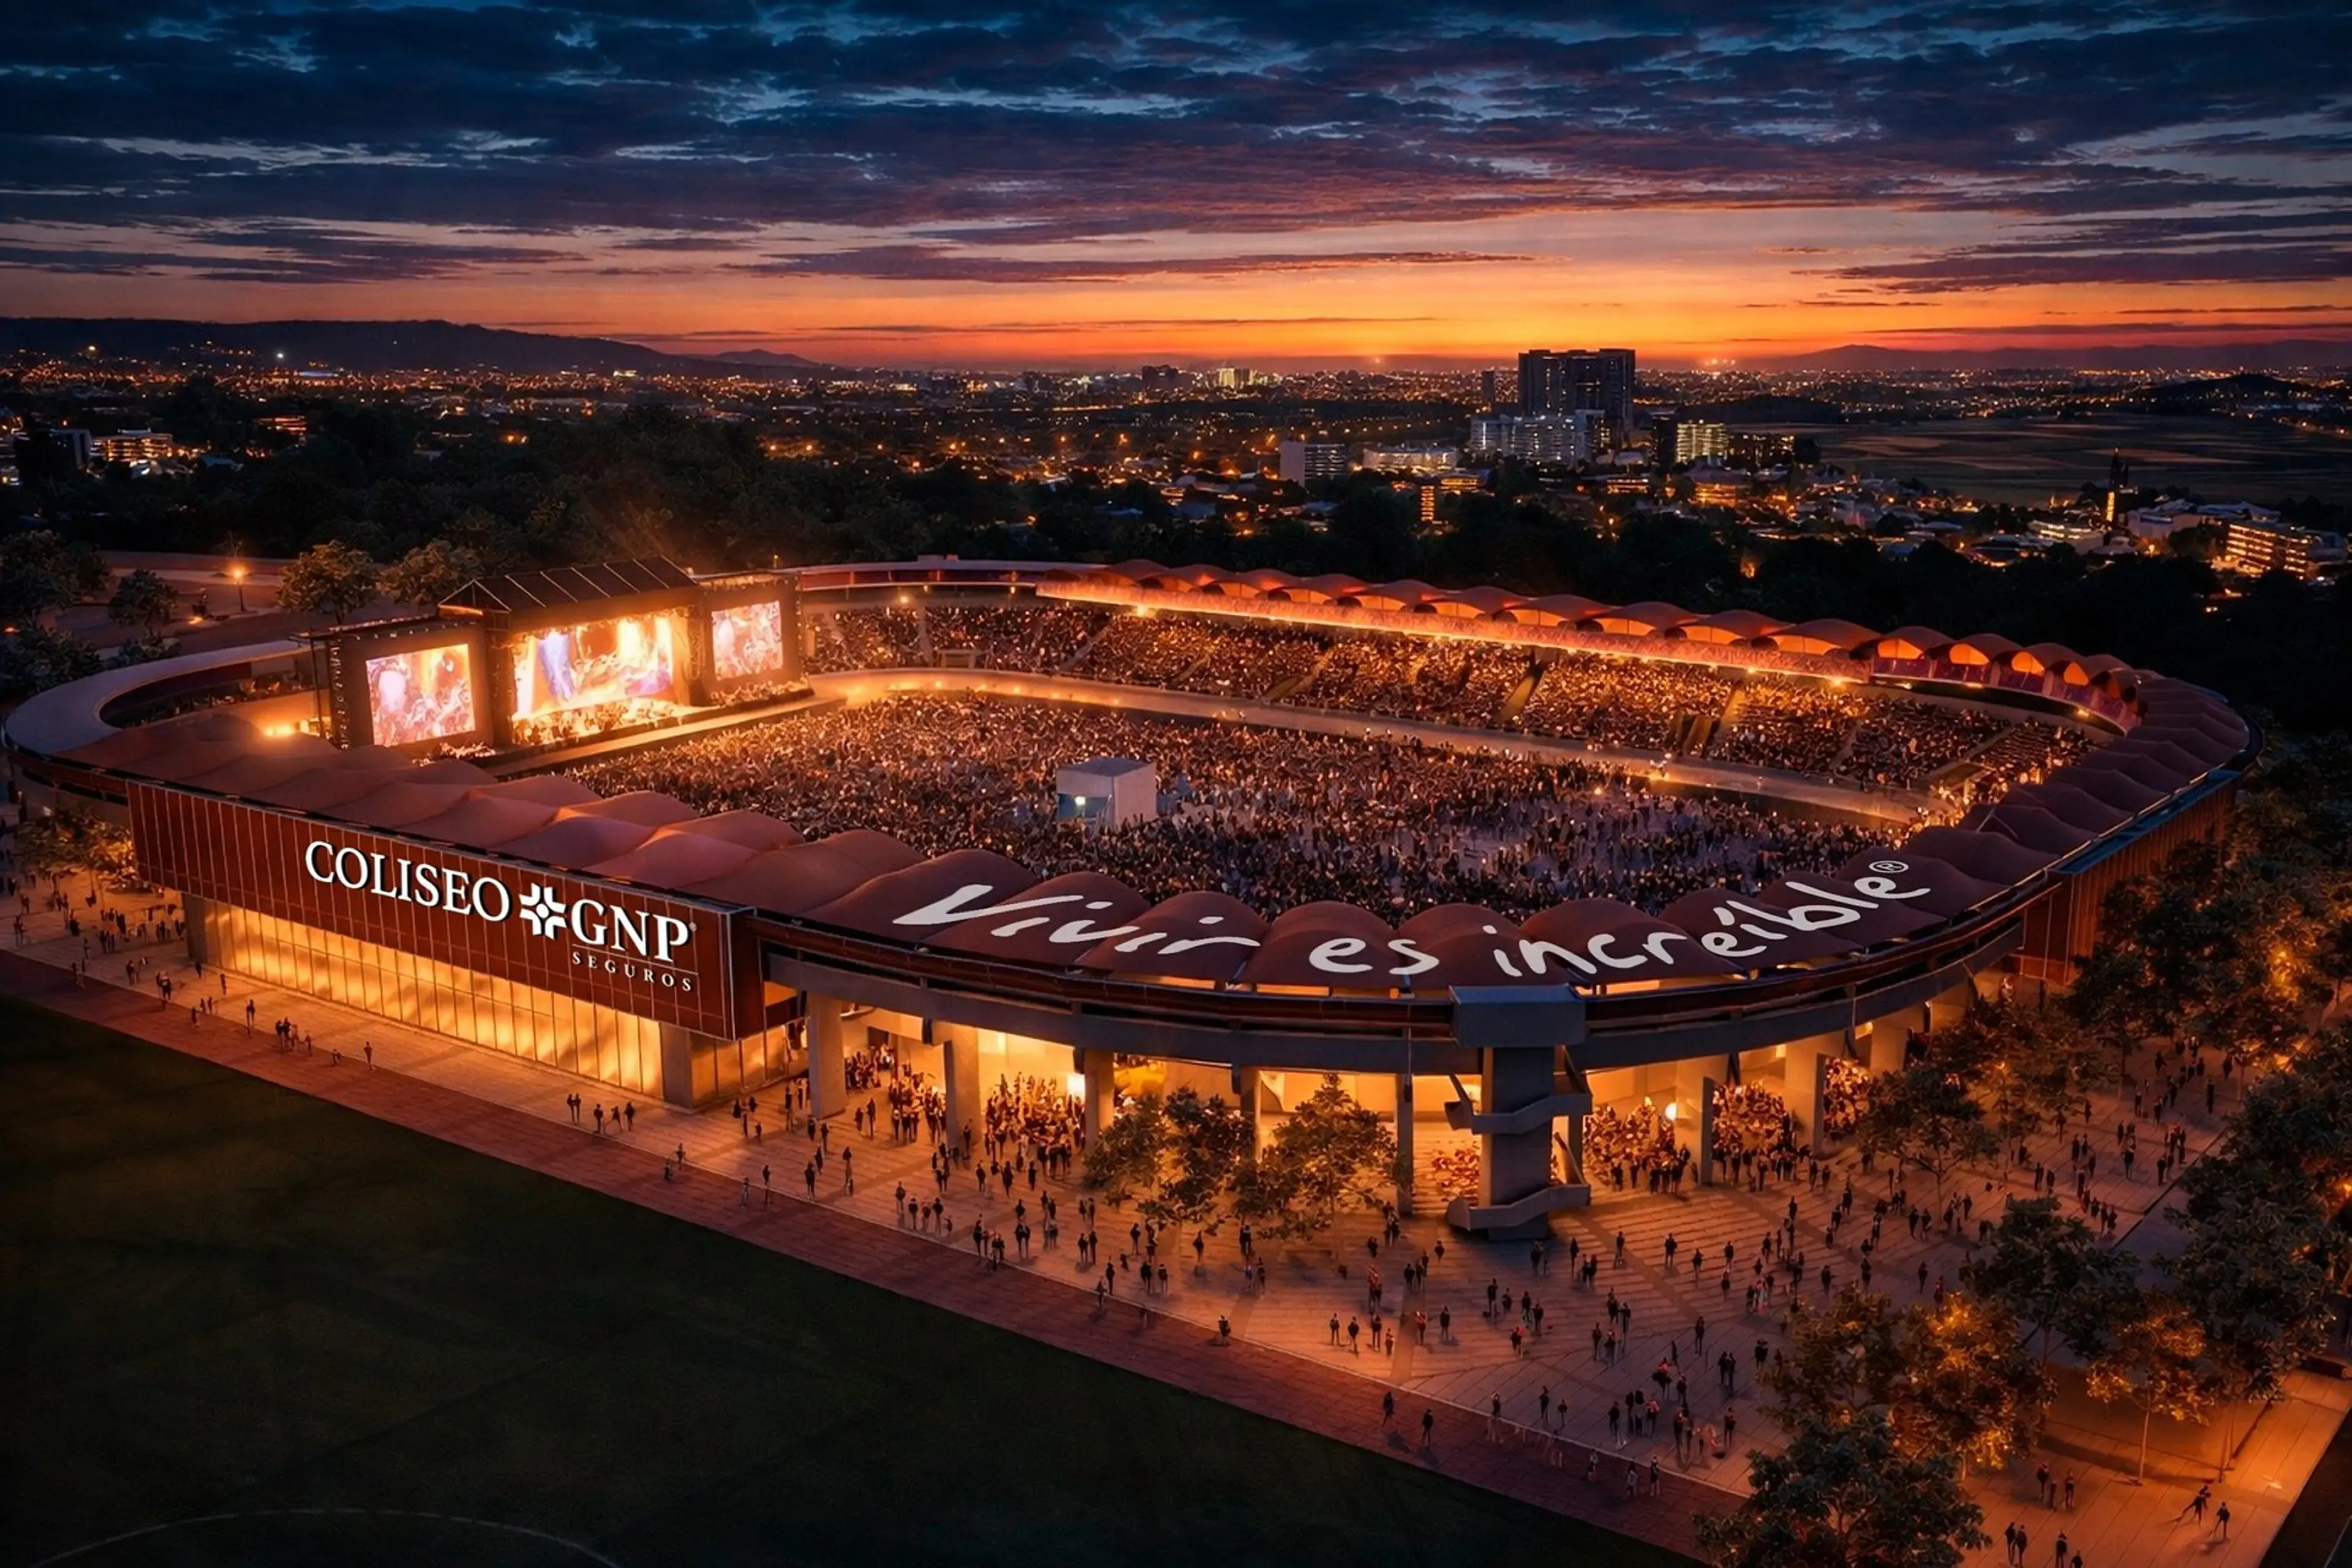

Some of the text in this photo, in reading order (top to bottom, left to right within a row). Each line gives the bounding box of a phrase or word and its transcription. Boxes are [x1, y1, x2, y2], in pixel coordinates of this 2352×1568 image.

[305, 840, 510, 922] COLISEO
[892, 884, 1261, 955] Vivir
[1309, 937, 1440, 976] es
[572, 951, 692, 992] SEGUROS
